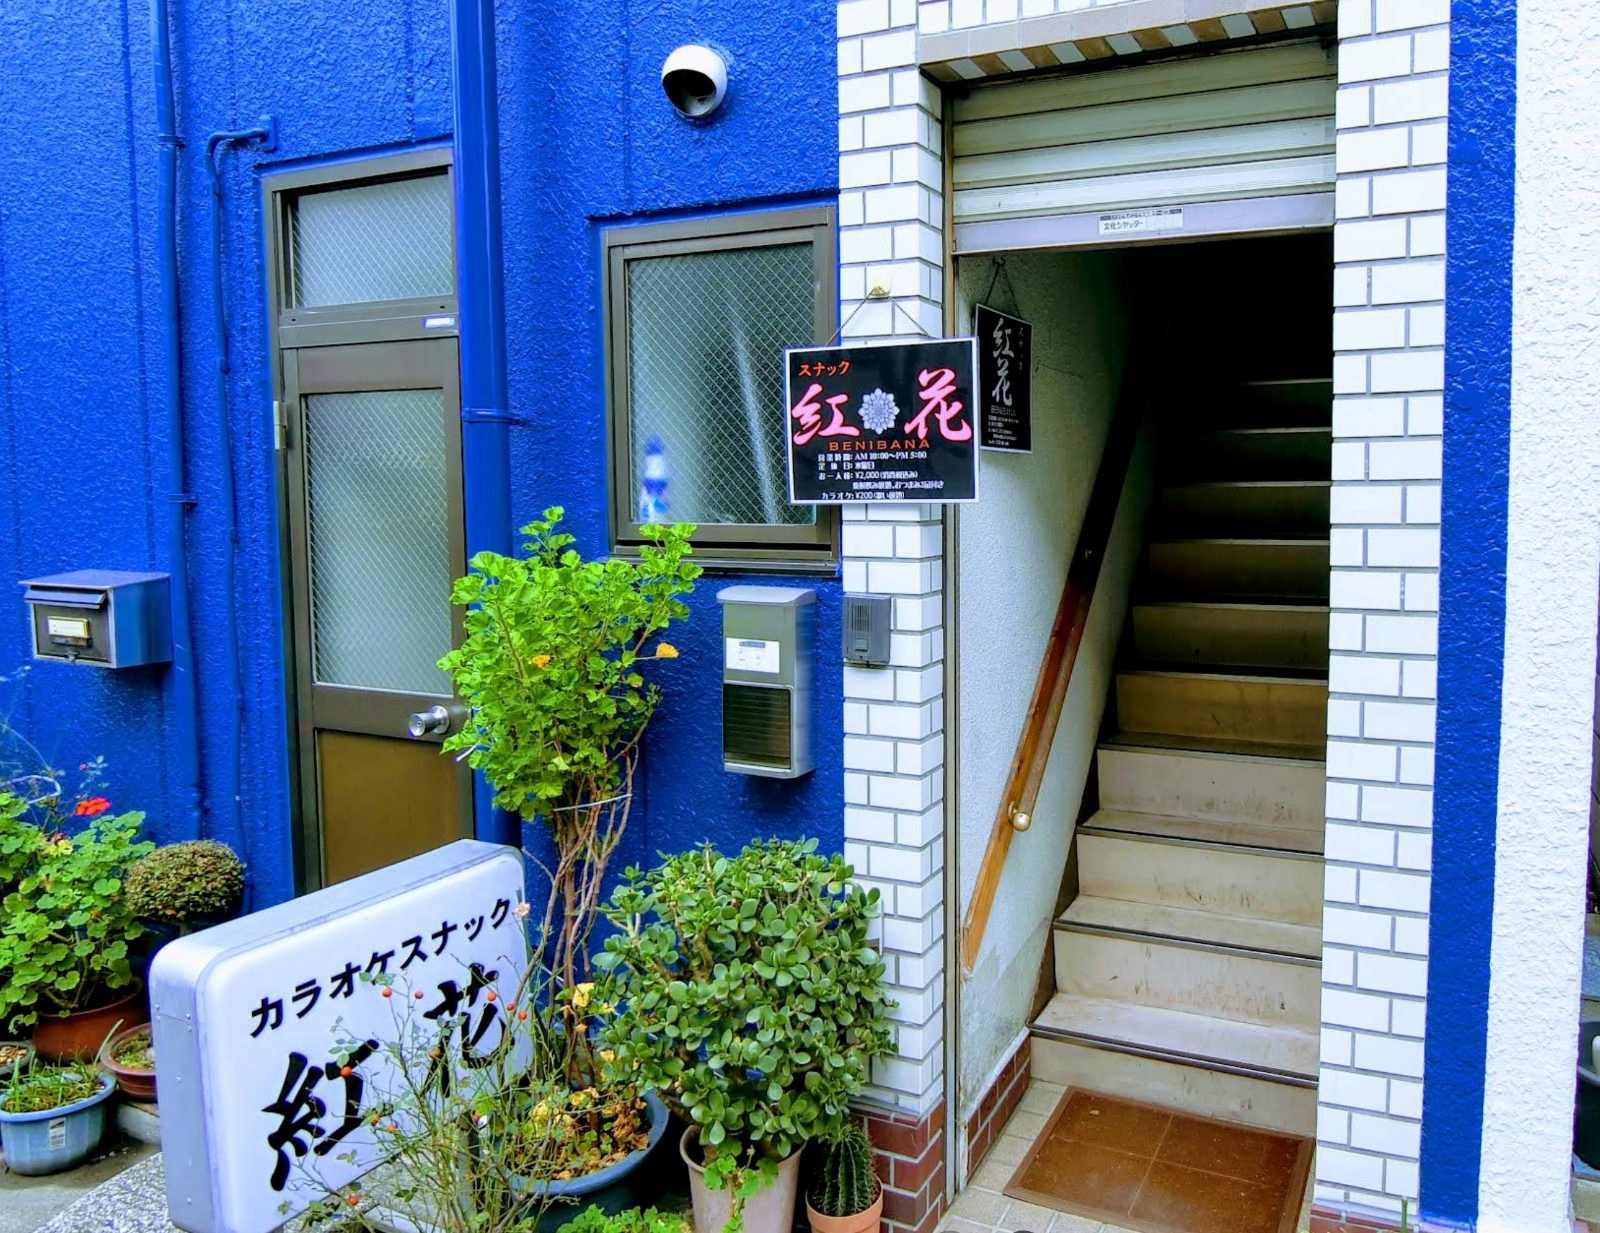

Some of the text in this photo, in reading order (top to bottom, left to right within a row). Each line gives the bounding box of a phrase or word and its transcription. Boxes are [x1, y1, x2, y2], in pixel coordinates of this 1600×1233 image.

[798, 360, 852, 377] スナック
[992, 317, 1015, 406] 紅花
[828, 439, 930, 452] BENIBANA
[250, 897, 511, 1038] カラオケスナック
